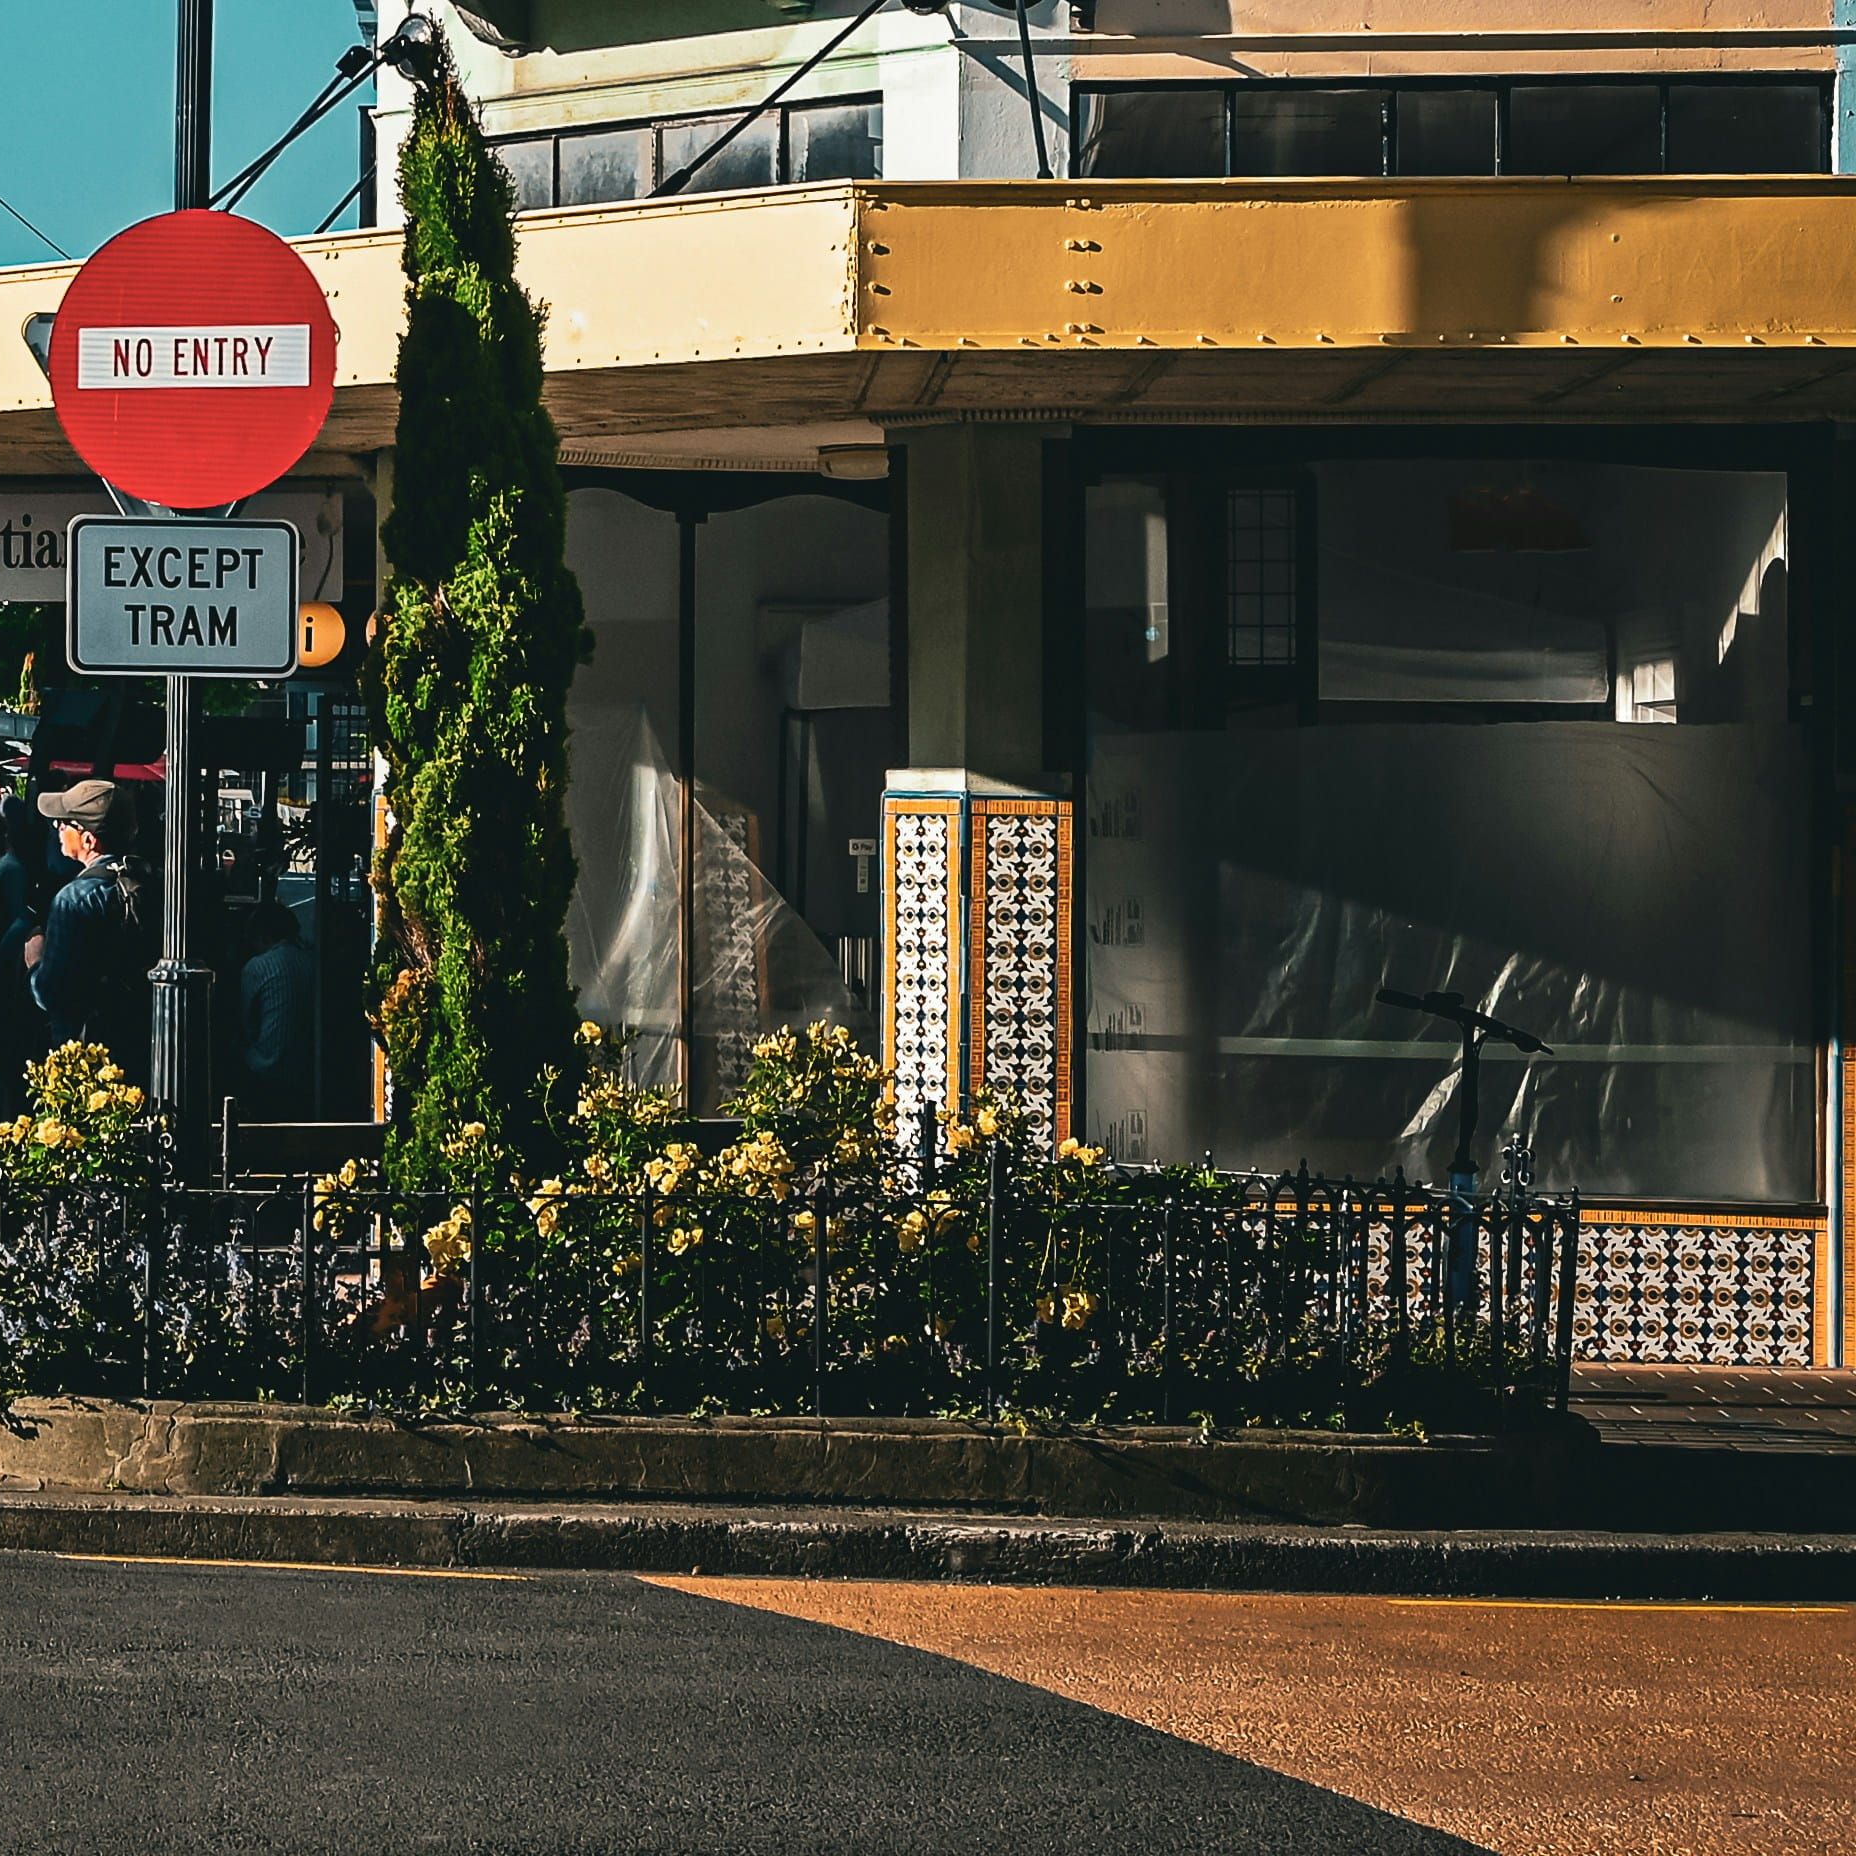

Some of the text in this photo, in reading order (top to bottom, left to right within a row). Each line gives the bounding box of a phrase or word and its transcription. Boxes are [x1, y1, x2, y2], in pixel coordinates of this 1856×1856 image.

[113, 335, 274, 378] NO ENTRY
[103, 545, 264, 590] EXCEPT
[124, 604, 239, 648] TRAM
